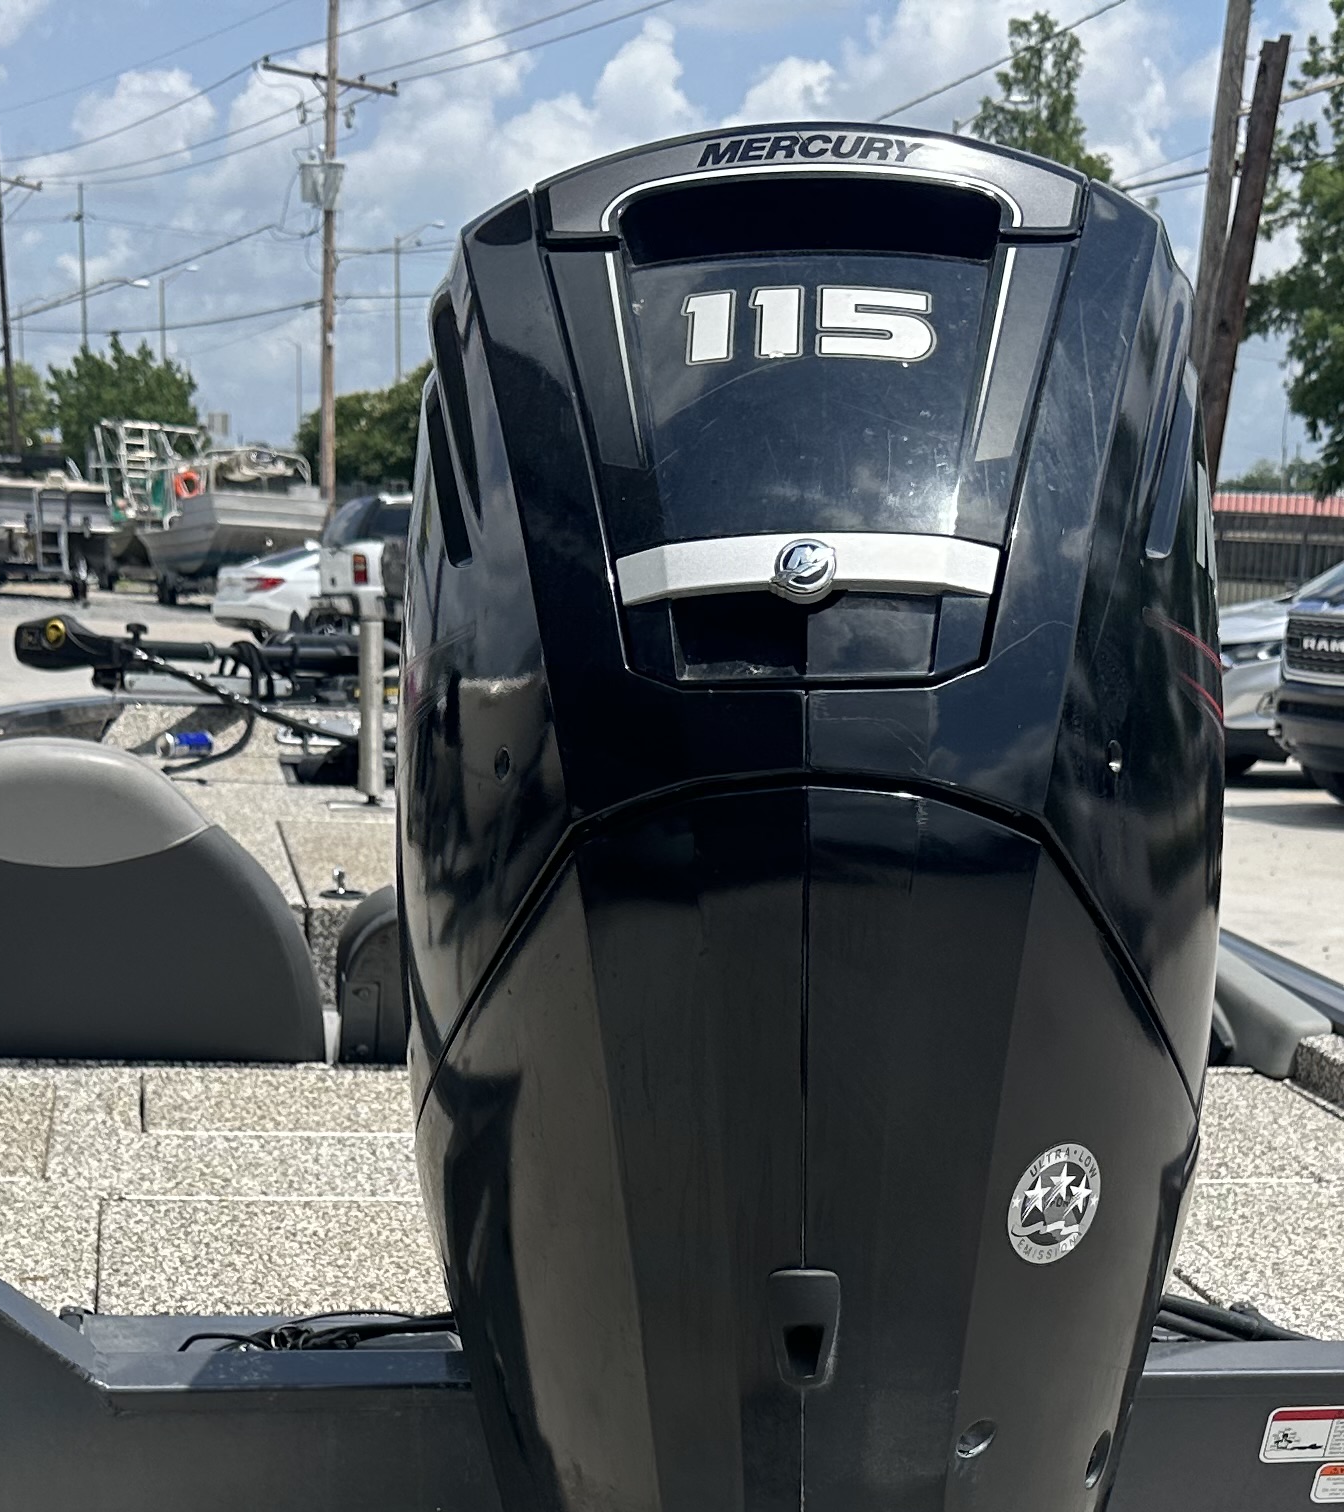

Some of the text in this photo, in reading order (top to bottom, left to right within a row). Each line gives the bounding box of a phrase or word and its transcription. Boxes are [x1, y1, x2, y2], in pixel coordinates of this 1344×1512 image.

[697, 134, 925, 168] MERCURY
[680, 284, 937, 365] 115
[1017, 1236, 1078, 1261] EMISSION
